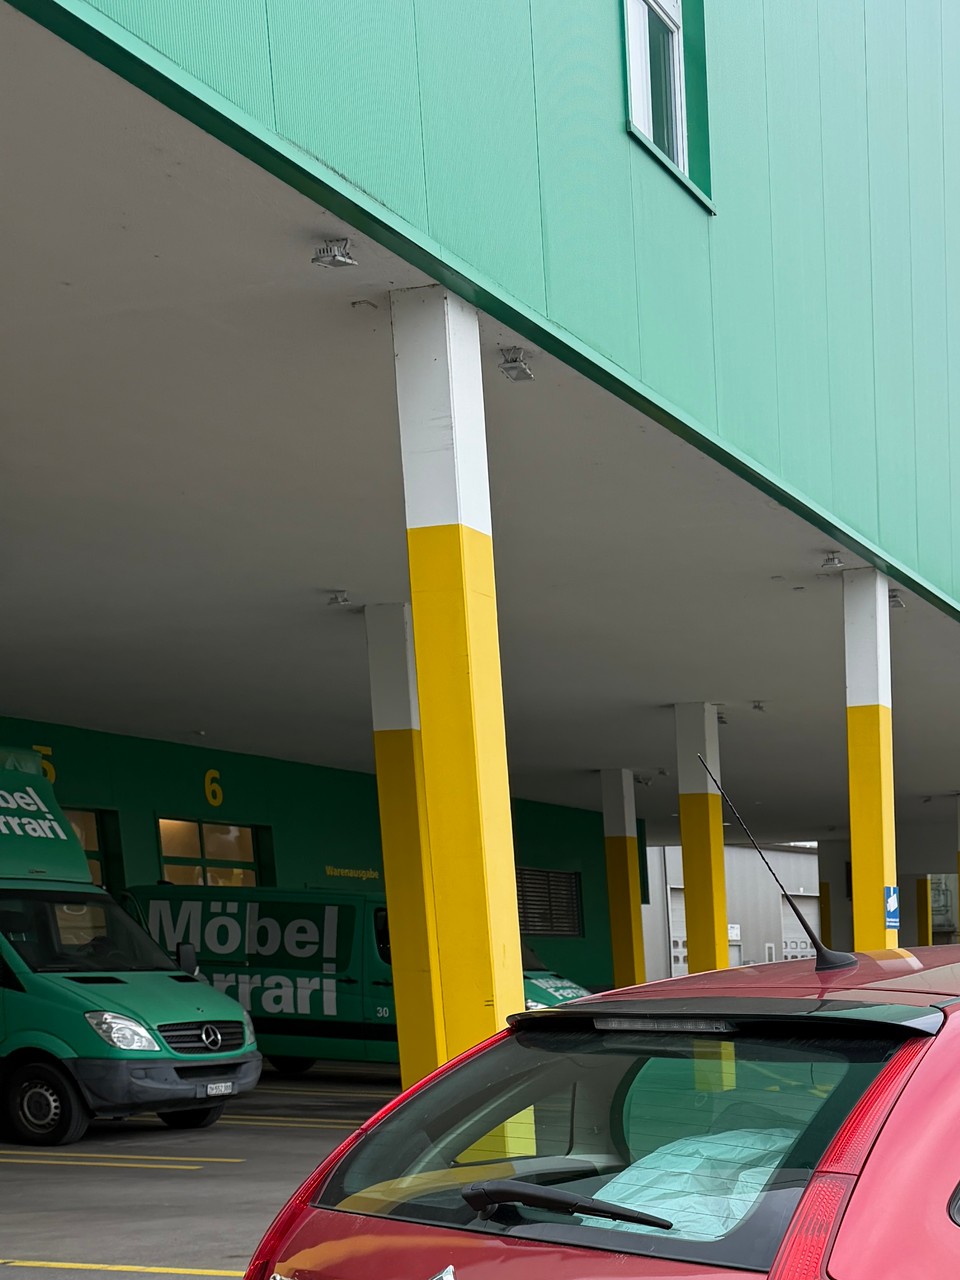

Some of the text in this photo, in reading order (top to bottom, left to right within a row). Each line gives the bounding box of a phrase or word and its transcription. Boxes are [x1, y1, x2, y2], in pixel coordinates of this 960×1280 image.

[205, 769, 223, 807] 6
[0, 813, 68, 840] rrari
[325, 865, 379, 880] Warenausgabe
[149, 900, 338, 958] Möbel
[200, 963, 338, 1016] rrari
[376, 1006, 389, 1018] 30
